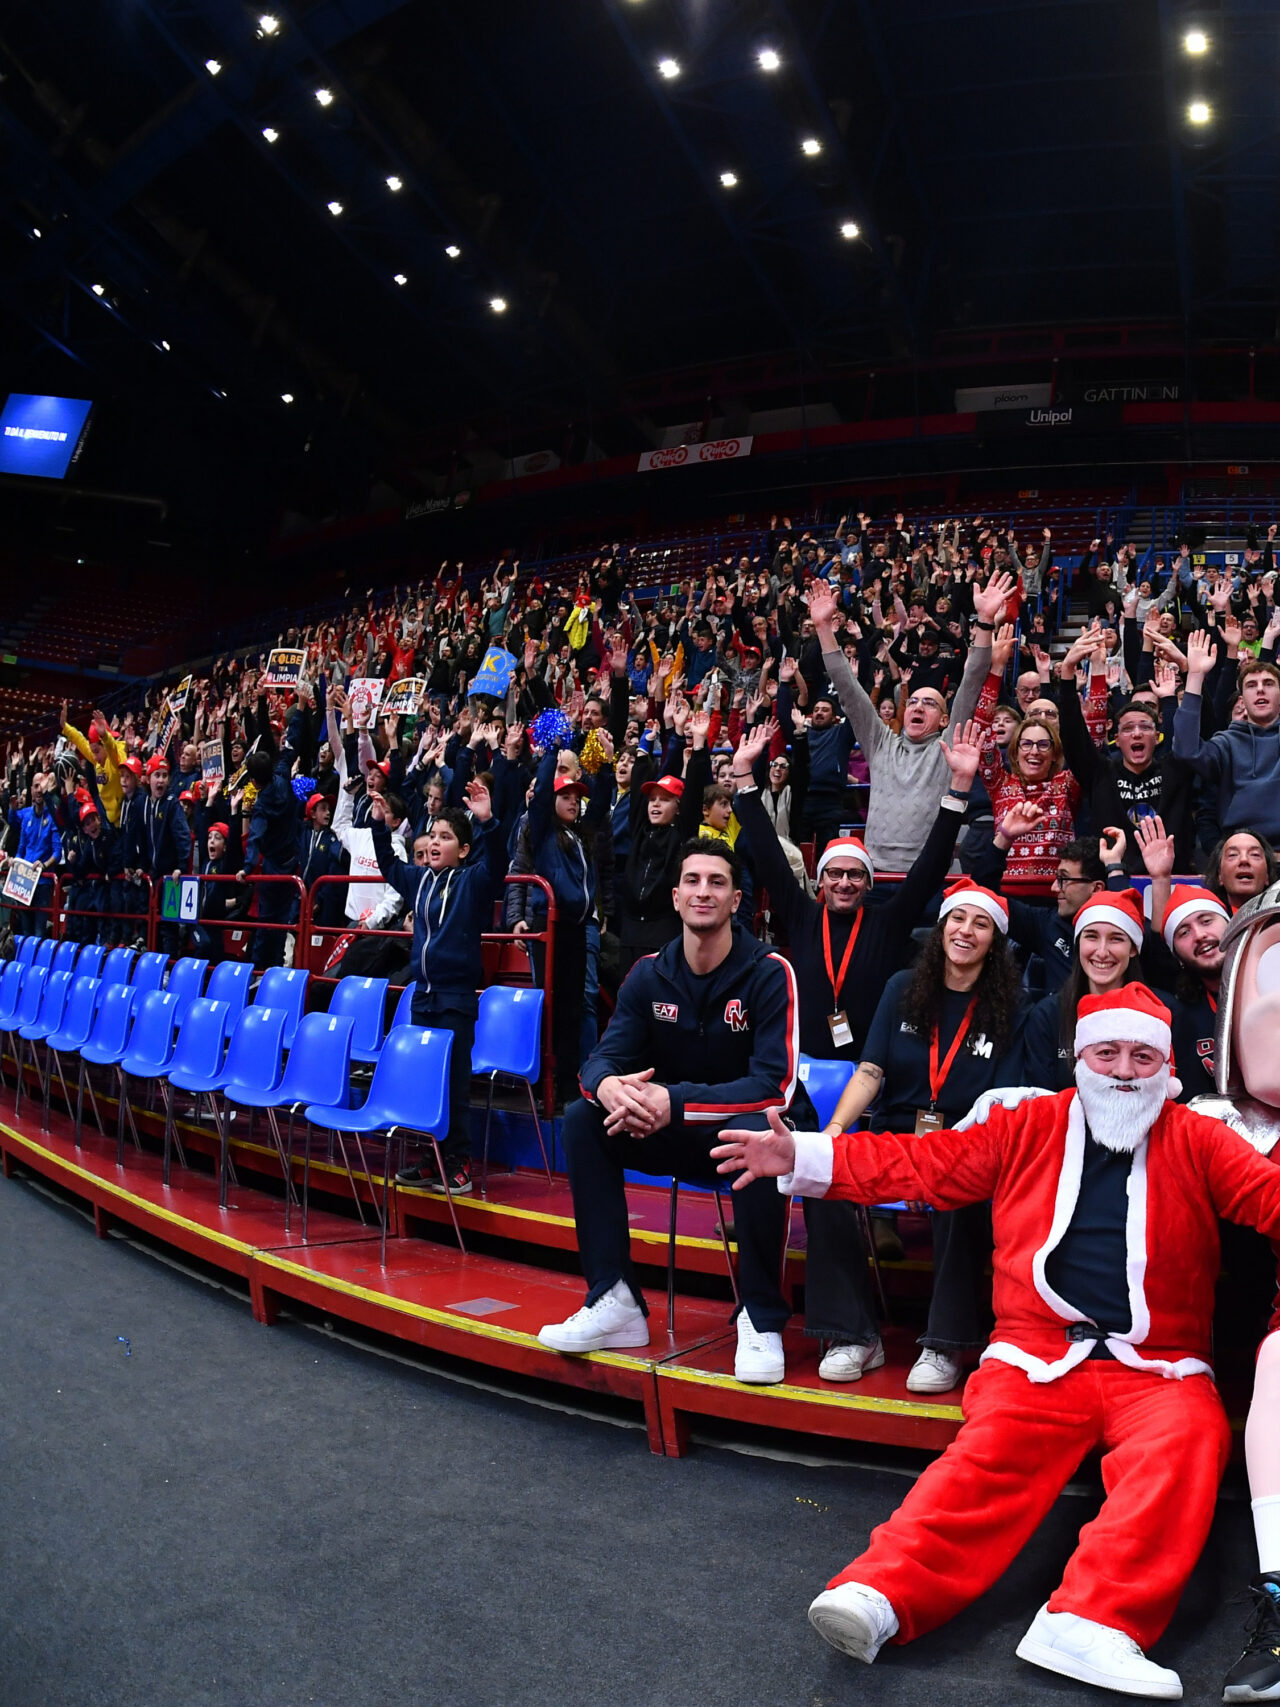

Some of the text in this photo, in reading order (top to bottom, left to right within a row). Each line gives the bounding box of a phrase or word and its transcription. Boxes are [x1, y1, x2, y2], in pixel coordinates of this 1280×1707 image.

[1030, 408, 1072, 426] Unipol
[482, 654, 501, 672] K
[1021, 833, 1045, 843] HOME
[167, 887, 193, 912] A 4
[653, 1004, 676, 1017] EA7
